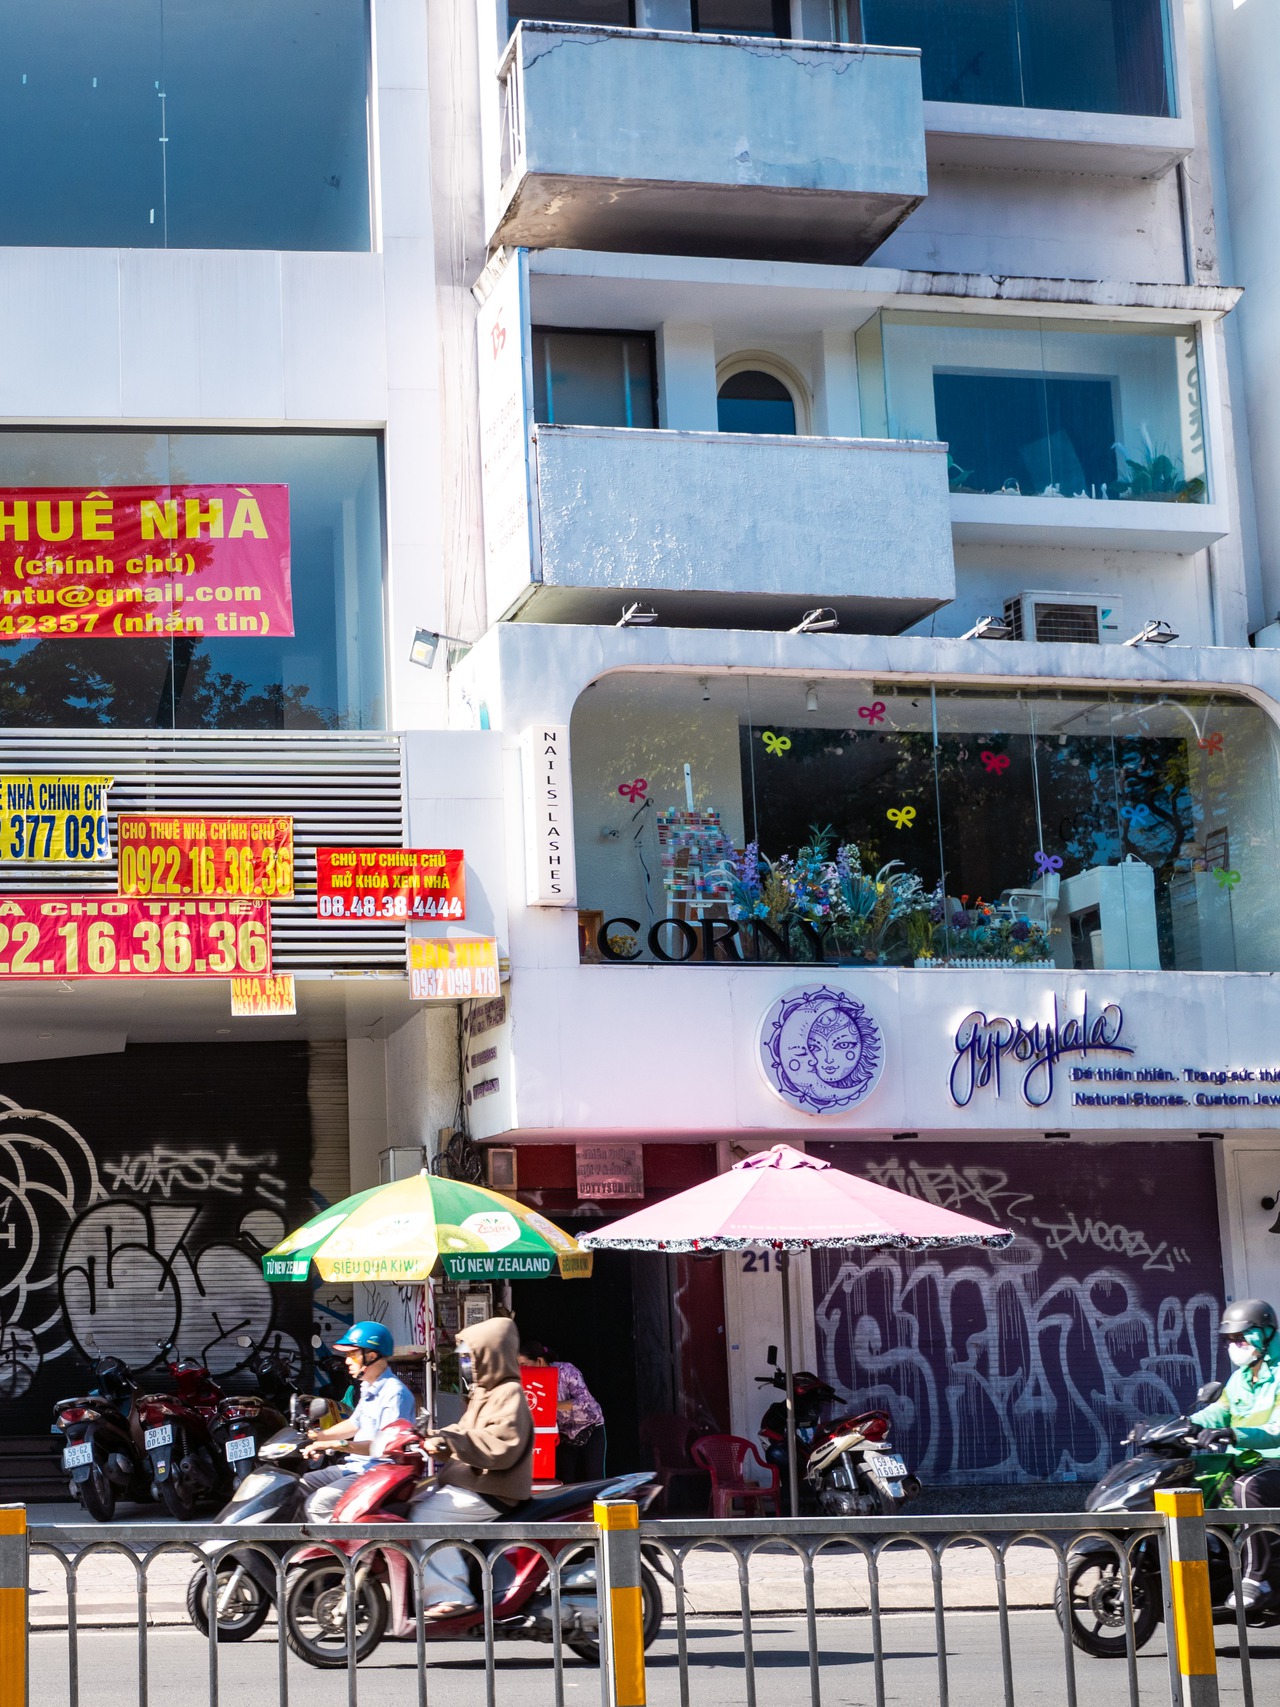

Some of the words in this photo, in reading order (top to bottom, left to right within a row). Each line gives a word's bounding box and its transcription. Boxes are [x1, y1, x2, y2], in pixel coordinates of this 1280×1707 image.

[140, 489, 268, 540] NHÀ
[14, 555, 114, 579] (chính
[126, 552, 195, 576] chủ)
[113, 611, 206, 635] (nhắn
[214, 611, 270, 634] tin)
[7, 777, 35, 811] NHÀ
[39, 777, 80, 811] CHÍNH
[9, 815, 56, 859] 377
[65, 814, 109, 859] 039
[122, 822, 147, 840] CHO
[150, 819, 180, 840] THUÊ
[183, 819, 207, 840] NHÀ
[210, 819, 248, 840] CHÍNH
[122, 845, 291, 895] 0922.16.36.36
[379, 851, 417, 866] CHÍNH
[421, 851, 446, 867] CHỦ
[331, 871, 352, 888] MỞ
[355, 872, 389, 888] KHÓA
[393, 875, 420, 888] XEM
[424, 874, 450, 889] NHÀ
[41, 902, 129, 916] CHO
[143, 900, 253, 915] THUÊ
[320, 895, 462, 917] 08.48.38.4444
[597, 917, 836, 961] CORNY
[412, 968, 444, 997] 0932
[447, 968, 472, 996] 099
[475, 967, 496, 994] 478
[1182, 1068, 1226, 1085] Trang
[1229, 1067, 1254, 1081] sức
[1073, 1092, 1129, 1106] Natural
[1194, 1092, 1249, 1106] Custom
[334, 1258, 360, 1274] SIÊU
[391, 1260, 418, 1273] KIWI
[450, 1256, 465, 1273] TỪ
[468, 1258, 494, 1272] NEW
[497, 1258, 550, 1272] ZEALAND
